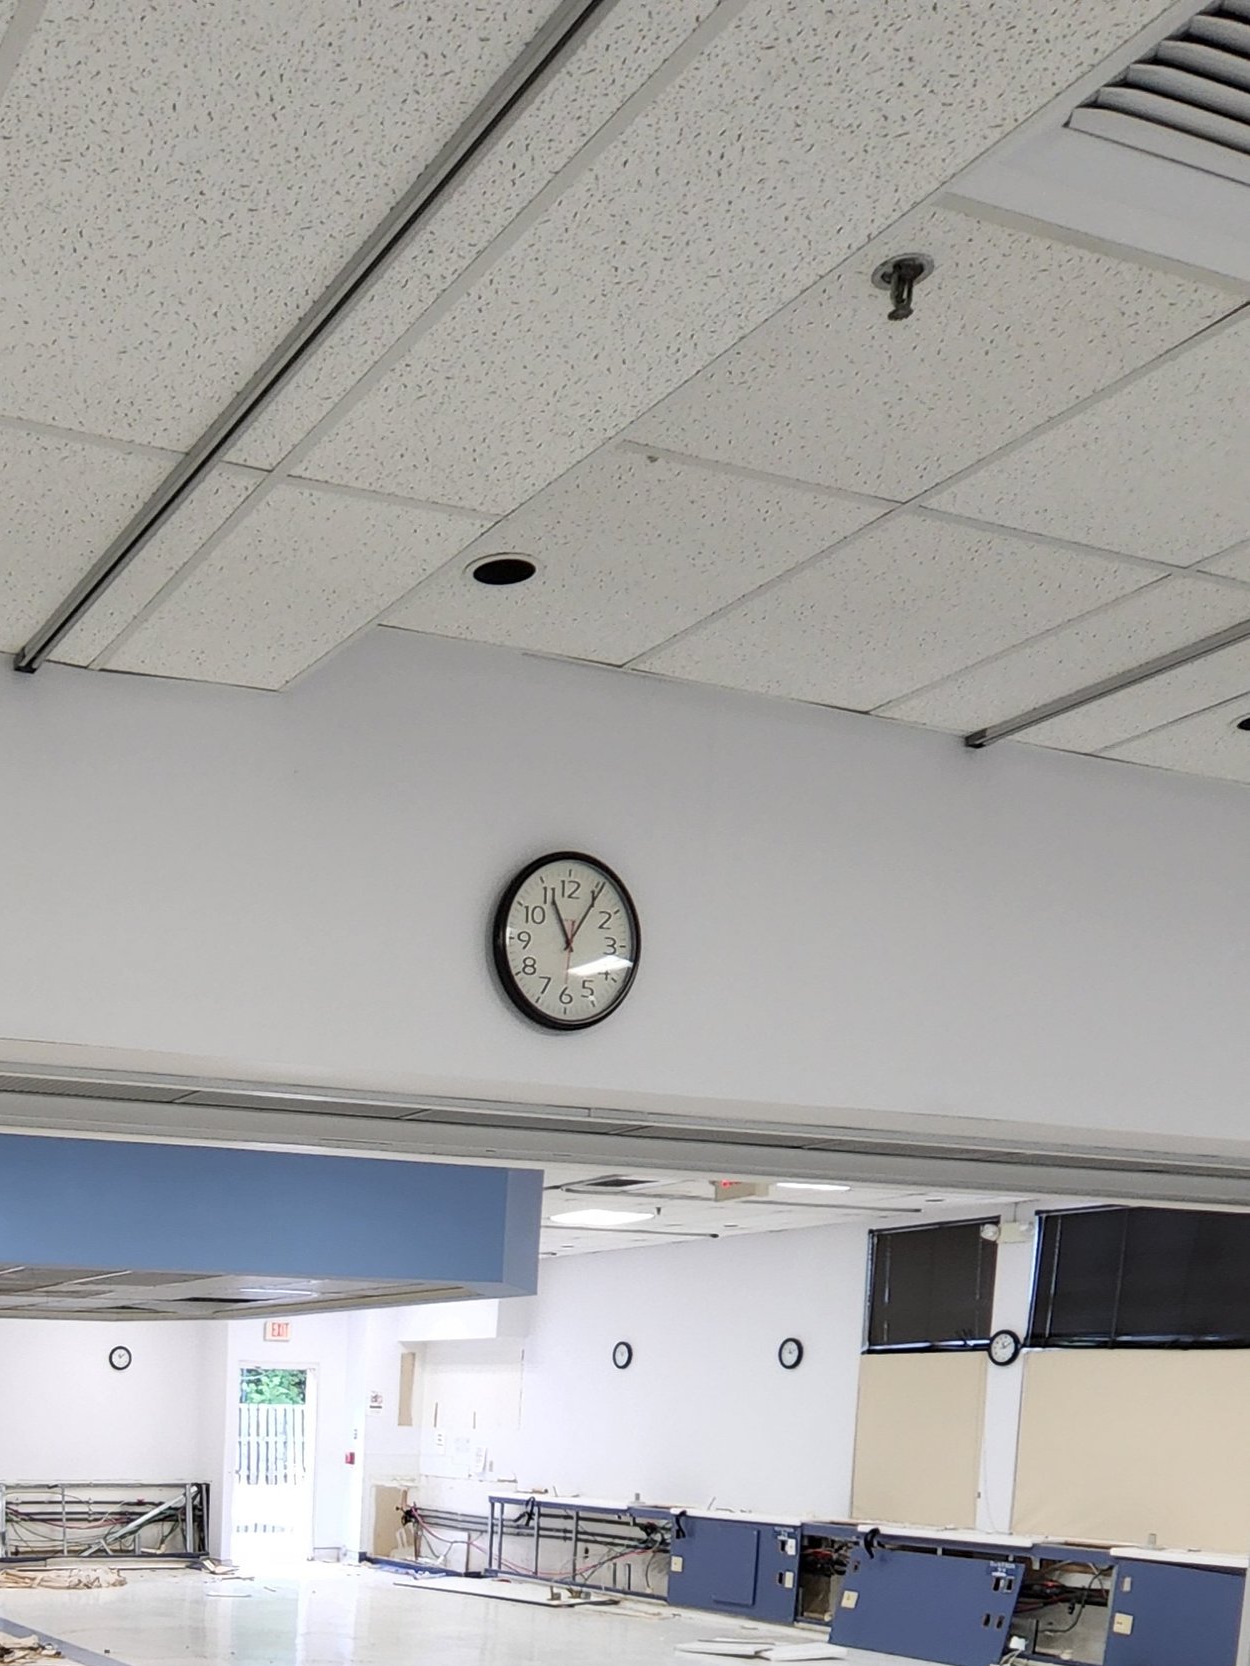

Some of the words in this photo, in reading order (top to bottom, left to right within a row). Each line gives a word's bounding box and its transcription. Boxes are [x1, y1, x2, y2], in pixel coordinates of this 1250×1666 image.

[543, 886, 556, 906] 11
[560, 879, 581, 900] 12
[524, 905, 546, 925] 10
[598, 911, 612, 930] 2
[517, 931, 532, 950] 9
[603, 937, 617, 956] 3
[521, 956, 537, 976] 8
[539, 976, 552, 995] 7
[581, 979, 595, 998] 5
[559, 986, 574, 1005] 6
